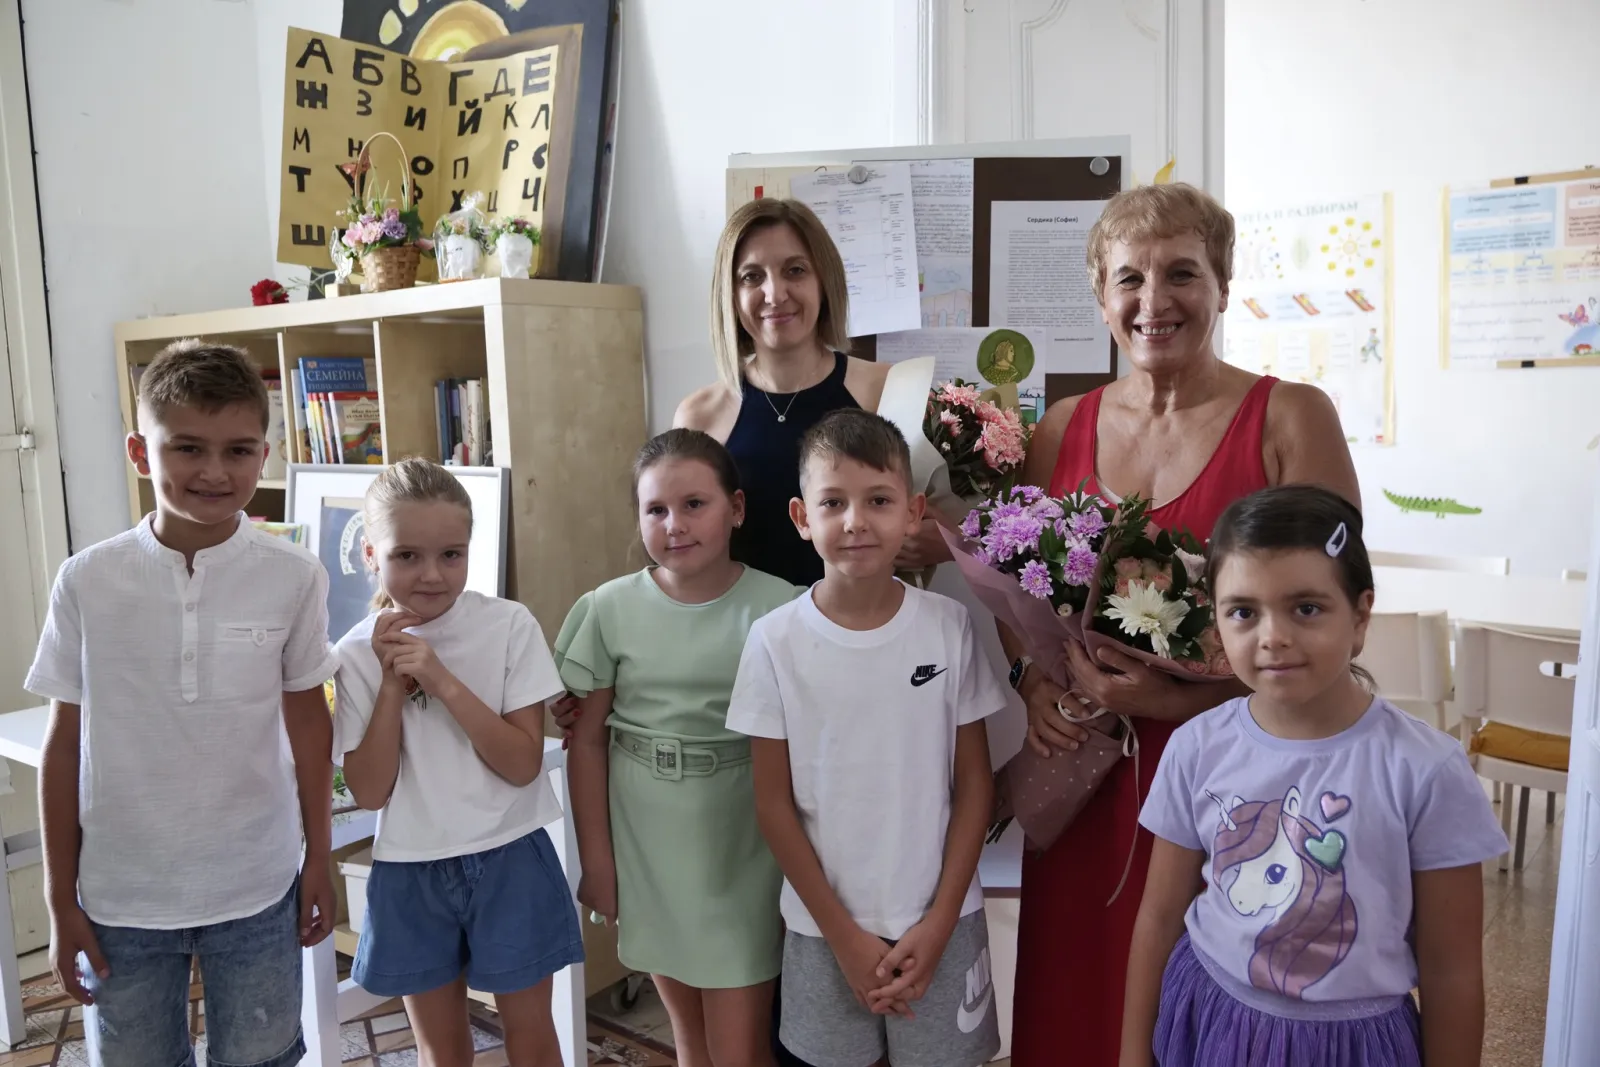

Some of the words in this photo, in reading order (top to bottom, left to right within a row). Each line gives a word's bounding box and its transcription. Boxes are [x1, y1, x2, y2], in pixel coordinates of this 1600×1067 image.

[296, 38, 333, 74] А
[353, 48, 385, 86] Б
[401, 58, 422, 96] В
[449, 69, 474, 107] Г
[484, 68, 516, 103] Д
[522, 53, 551, 97] Е
[296, 79, 328, 109] Ж
[356, 89, 372, 116] З
[404, 105, 426, 131] И
[457, 98, 482, 136] Й
[503, 101, 519, 131] К
[531, 103, 550, 131] Л
[293, 127, 310, 153] М
[348, 137, 363, 157] Н
[411, 155, 434, 176] О
[453, 156, 469, 180] П
[502, 139, 519, 170] Р
[289, 165, 311, 192] Т
[449, 189, 465, 214] Х
[487, 190, 498, 213] Ц
[522, 177, 541, 212] Ч
[291, 223, 325, 246] Ш
[306, 369, 364, 381] СЕМЕЙНА
[915, 664, 937, 678] NIKE
